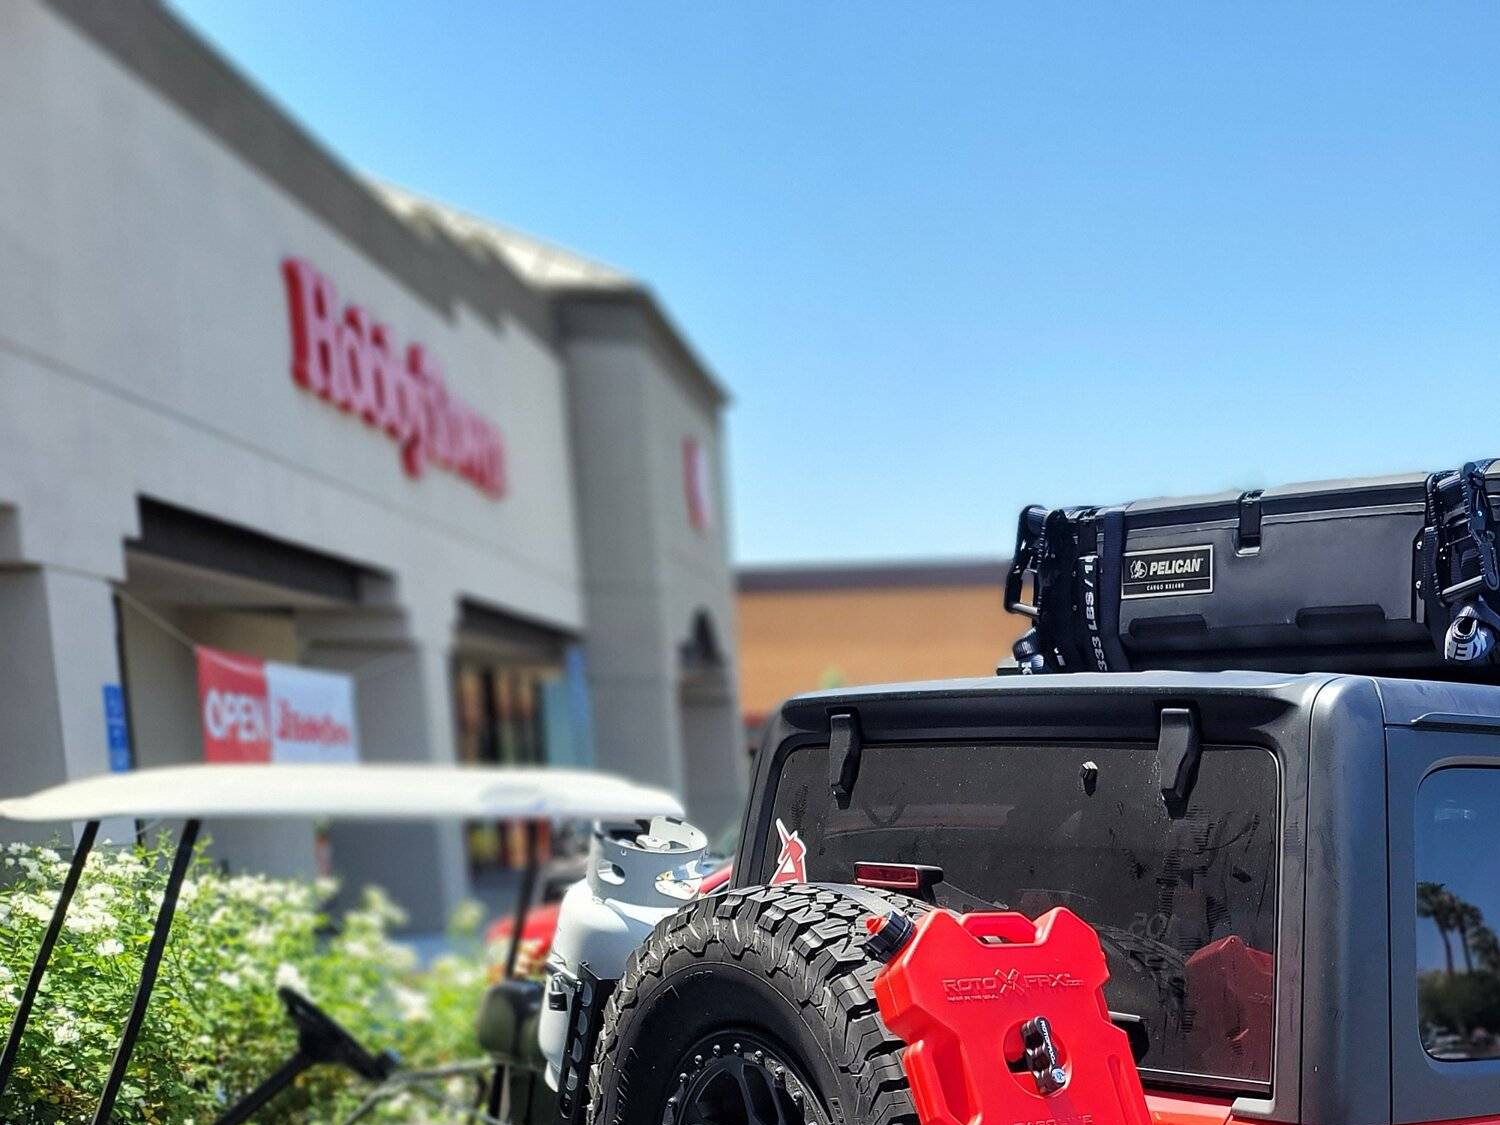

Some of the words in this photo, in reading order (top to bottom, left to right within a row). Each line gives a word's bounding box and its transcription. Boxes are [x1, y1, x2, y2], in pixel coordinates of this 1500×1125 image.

[1149, 558, 1201, 576] PELICAN
[1085, 591, 1098, 631] LBS
[204, 686, 273, 742] OPEN
